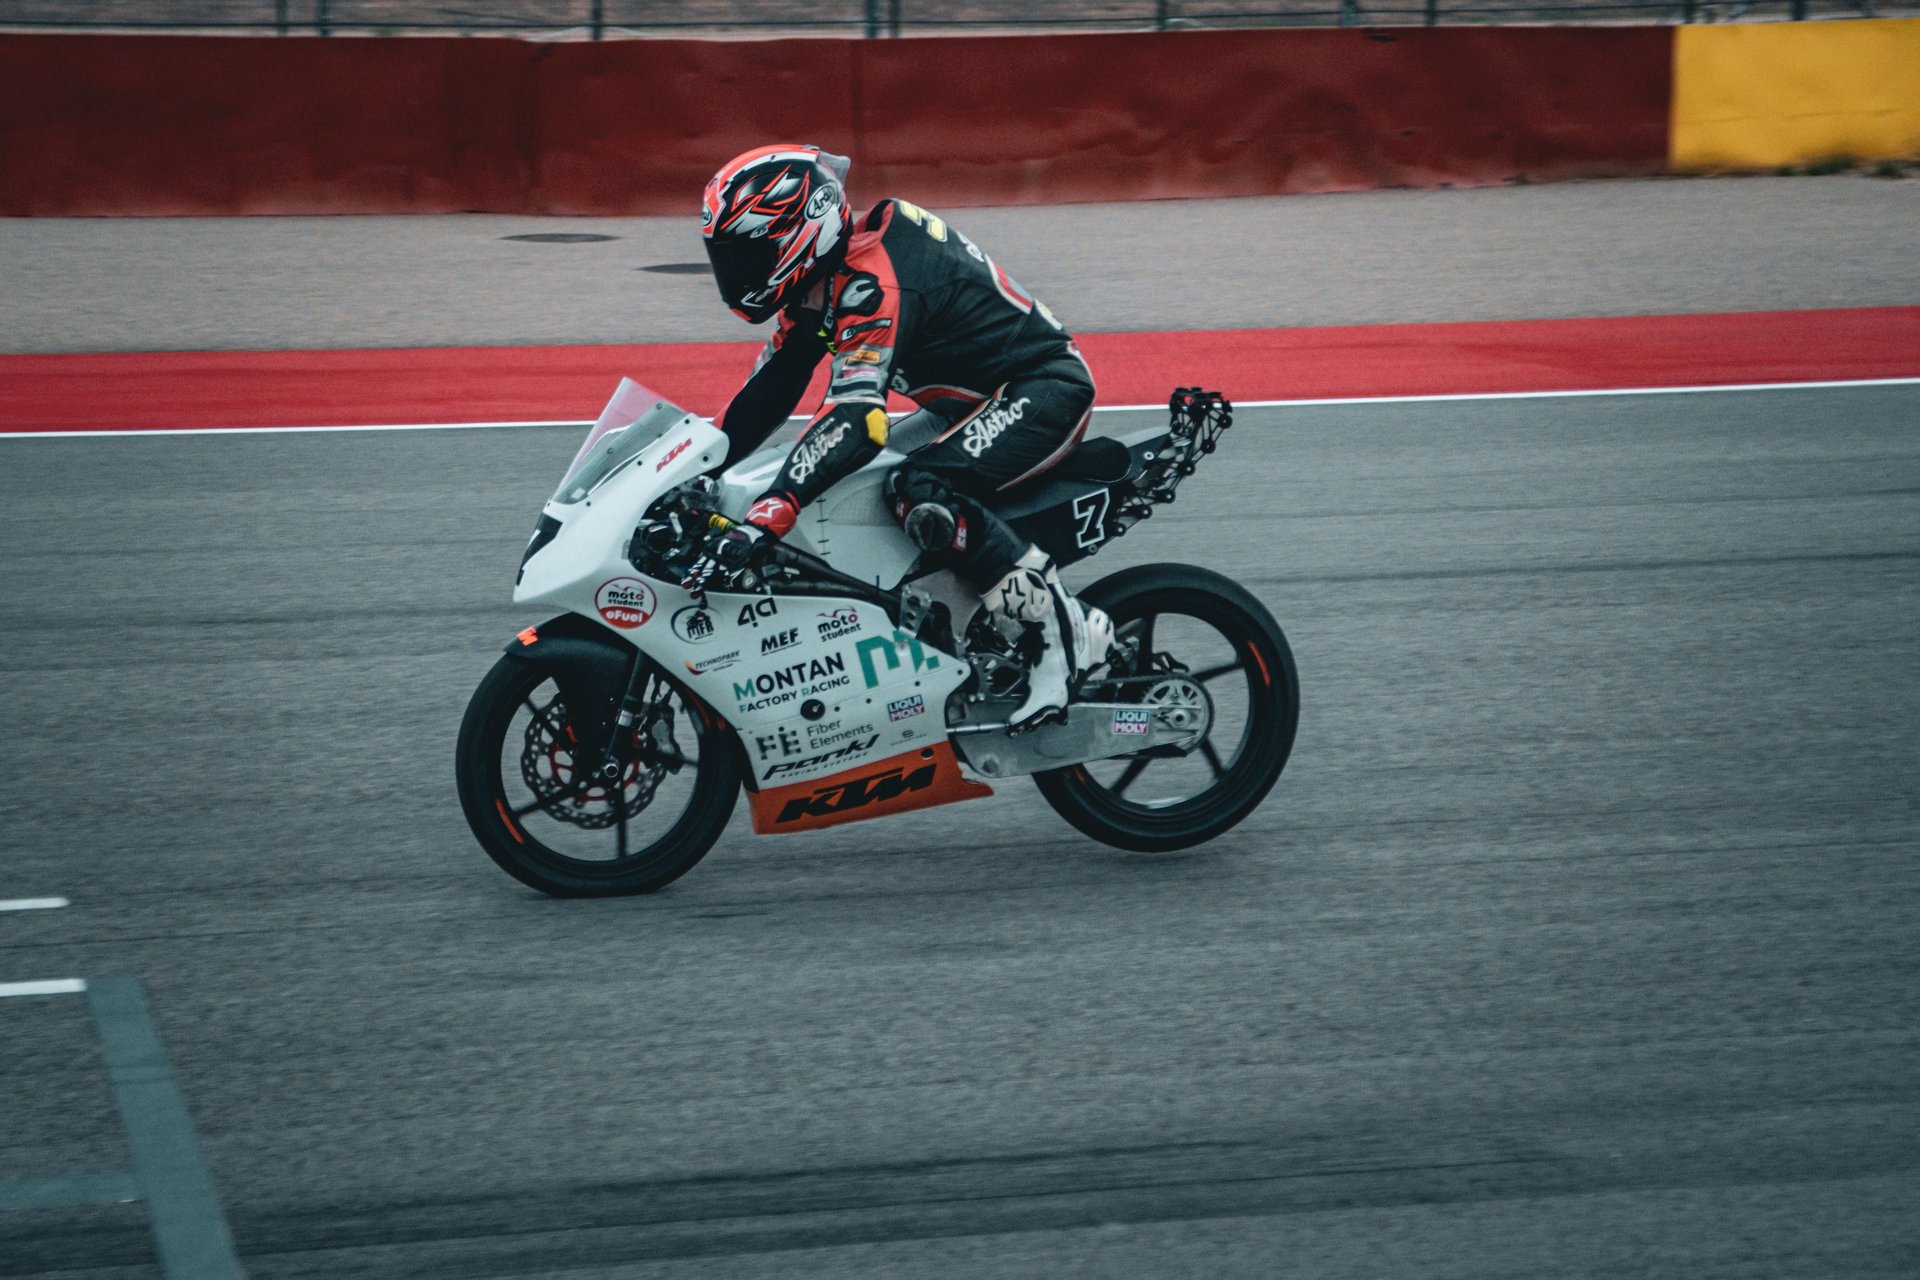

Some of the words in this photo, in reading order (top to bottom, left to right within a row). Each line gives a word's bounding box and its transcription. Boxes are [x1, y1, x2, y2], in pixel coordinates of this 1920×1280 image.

[963, 397, 1031, 457] Astro
[655, 438, 692, 473] KTM
[789, 422, 852, 484] Astro
[1073, 488, 1110, 549] 7
[608, 589, 644, 601] moto
[608, 598, 644, 607] student
[606, 610, 643, 623] eFuel
[818, 612, 859, 634] moto
[761, 628, 799, 653] MEF
[821, 623, 862, 643] student
[695, 650, 740, 669] TECHNOPARK
[733, 652, 845, 701] MONTAN
[739, 692, 797, 713] FACTORY
[801, 676, 850, 697] RACING
[889, 695, 923, 712] LIQUI
[891, 705, 925, 721] MOLY
[1116, 710, 1148, 722] LIQUI
[807, 720, 841, 737] Fiber
[810, 724, 874, 749] Elements
[1115, 722, 1148, 734] MOLY
[775, 764, 936, 823] KTM
